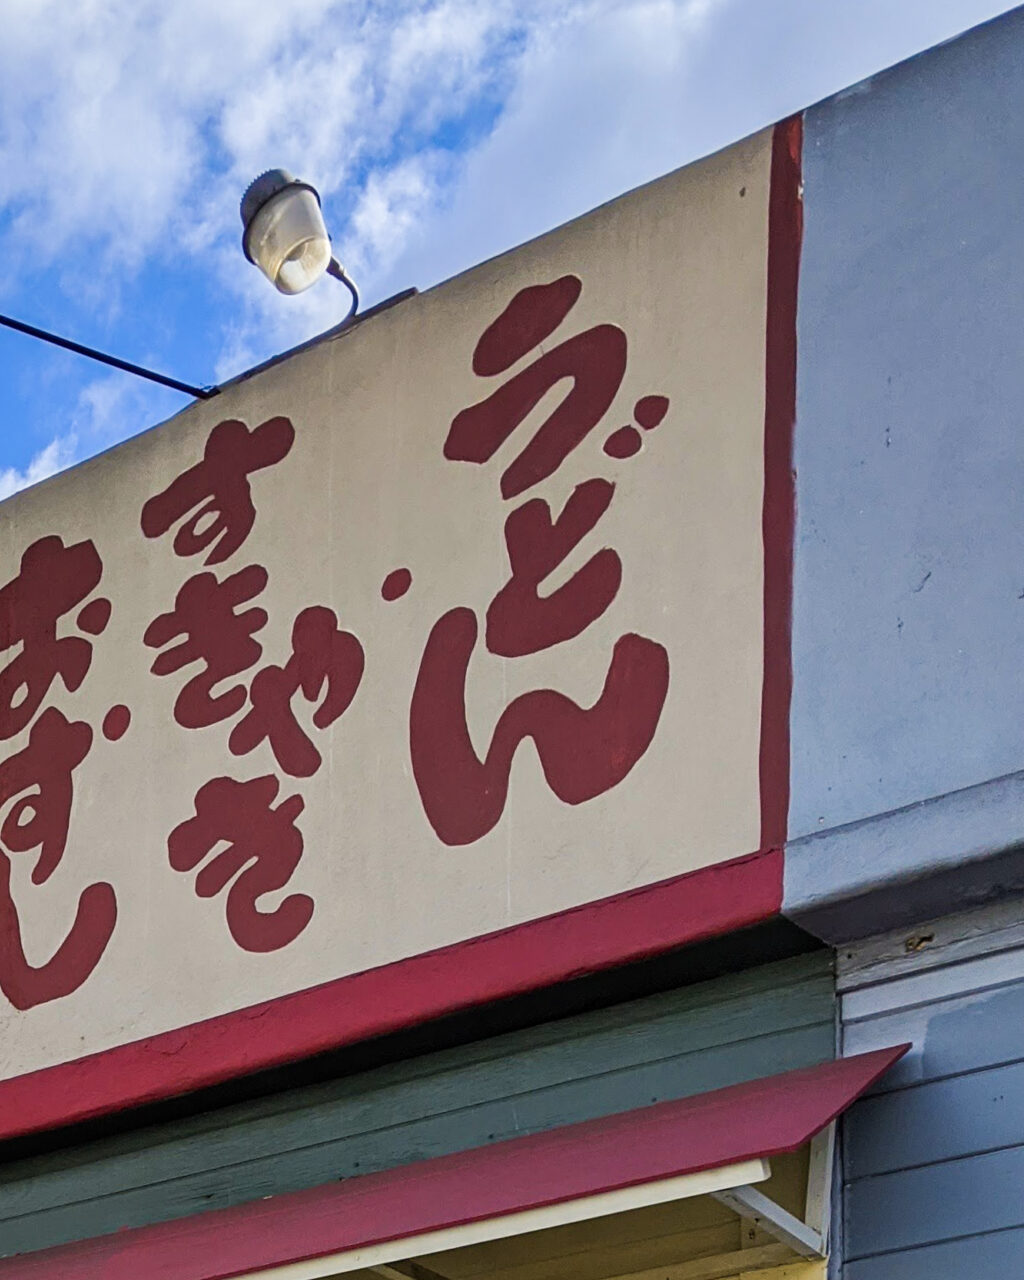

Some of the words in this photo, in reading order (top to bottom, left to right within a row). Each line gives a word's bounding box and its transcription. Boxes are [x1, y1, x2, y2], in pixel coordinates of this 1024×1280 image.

[140, 415, 365, 954] すきやき
[409, 274, 670, 848] うどん
